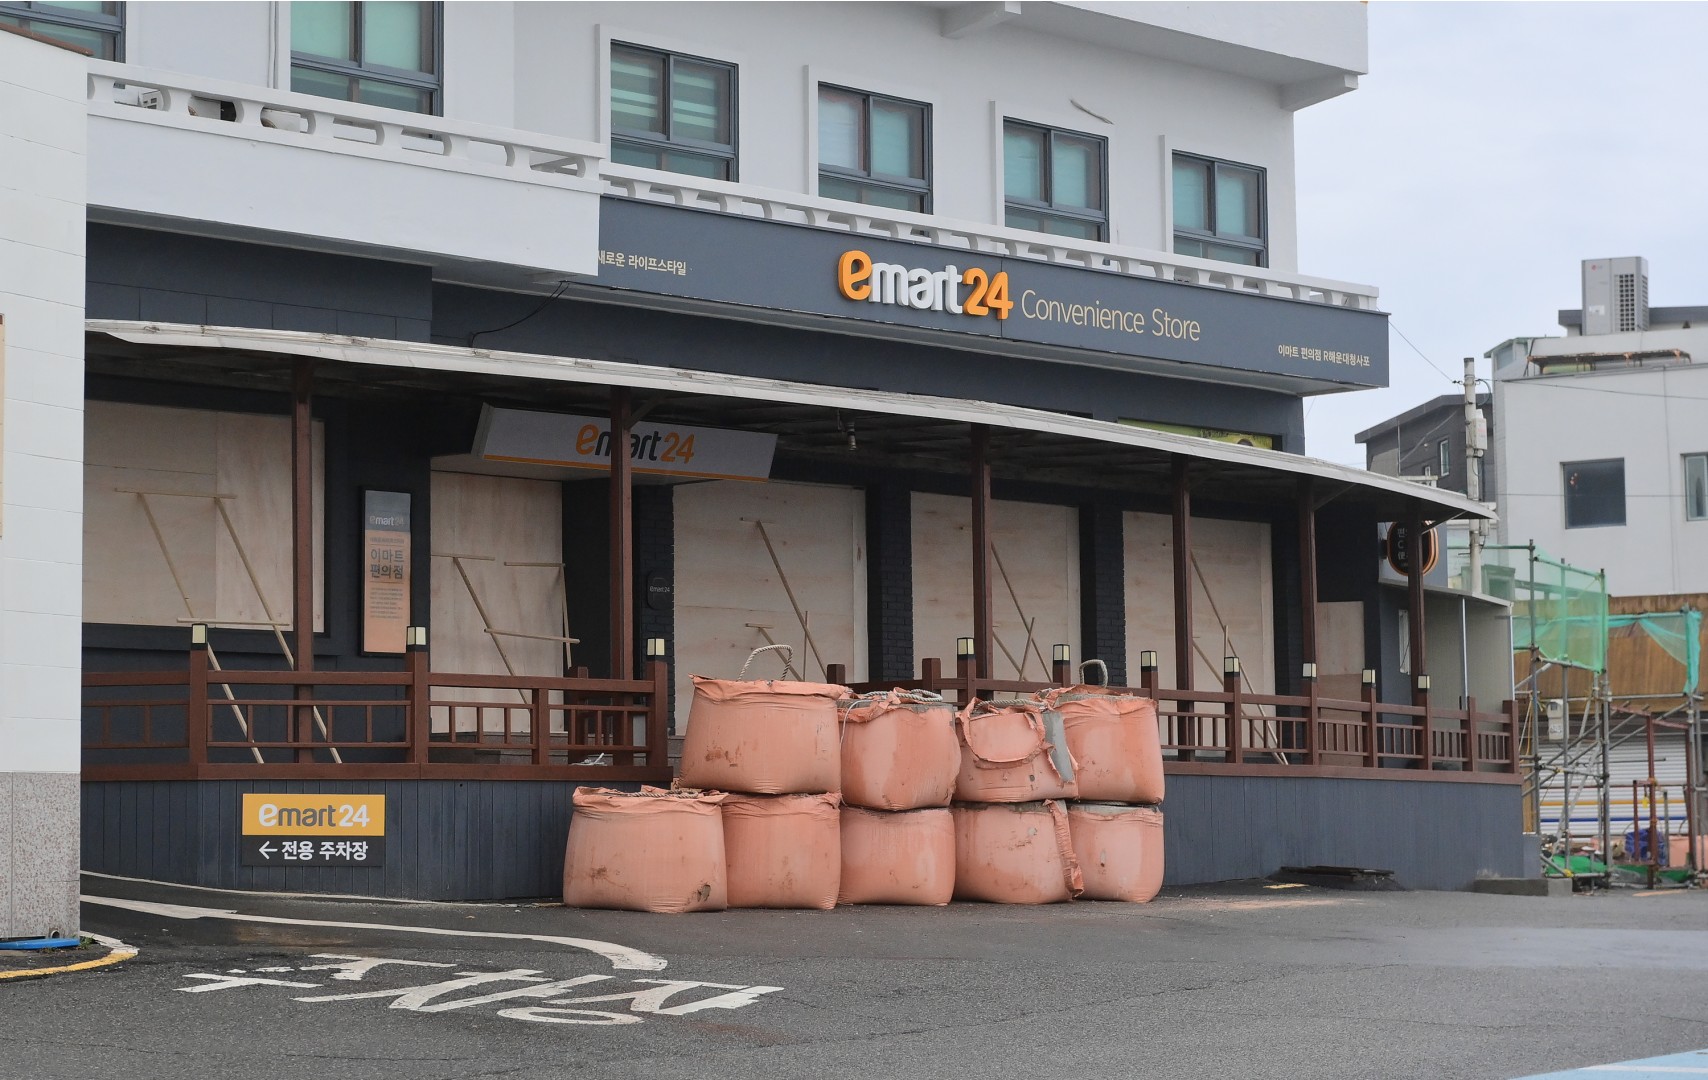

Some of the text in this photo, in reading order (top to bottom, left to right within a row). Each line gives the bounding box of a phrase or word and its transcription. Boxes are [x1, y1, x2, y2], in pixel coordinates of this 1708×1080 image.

[628, 254, 687, 276] 라이프스타일
[838, 250, 1014, 320] emart24
[1021, 289, 1201, 343] Convenience Store
[1278, 344, 1299, 358] 이마트
[1300, 347, 1321, 361] 편의점
[370, 548, 405, 564] 이마트
[370, 563, 404, 580] 편의점
[281, 840, 368, 861] 전용 주차장
